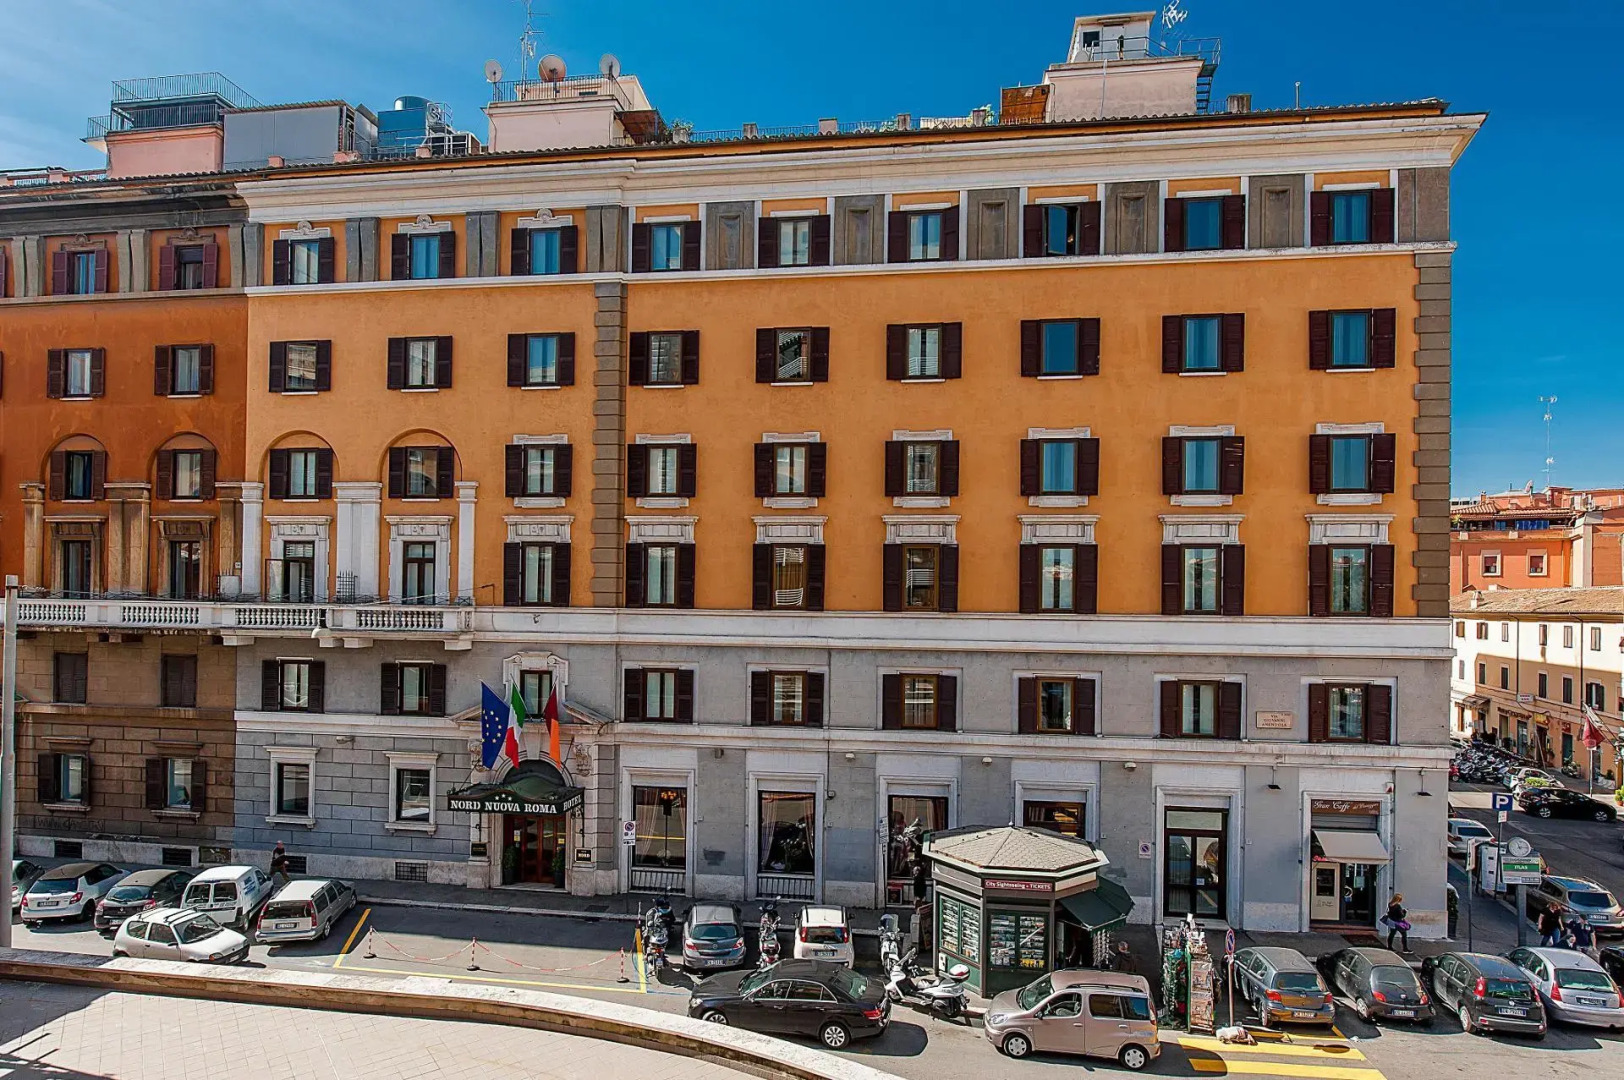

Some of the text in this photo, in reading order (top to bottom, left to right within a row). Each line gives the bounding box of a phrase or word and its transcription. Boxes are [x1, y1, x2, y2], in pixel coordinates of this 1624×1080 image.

[450, 800, 557, 814] NORD NUOVA ROMA
[563, 794, 582, 811] HOTEL
[1496, 796, 1508, 809] P
